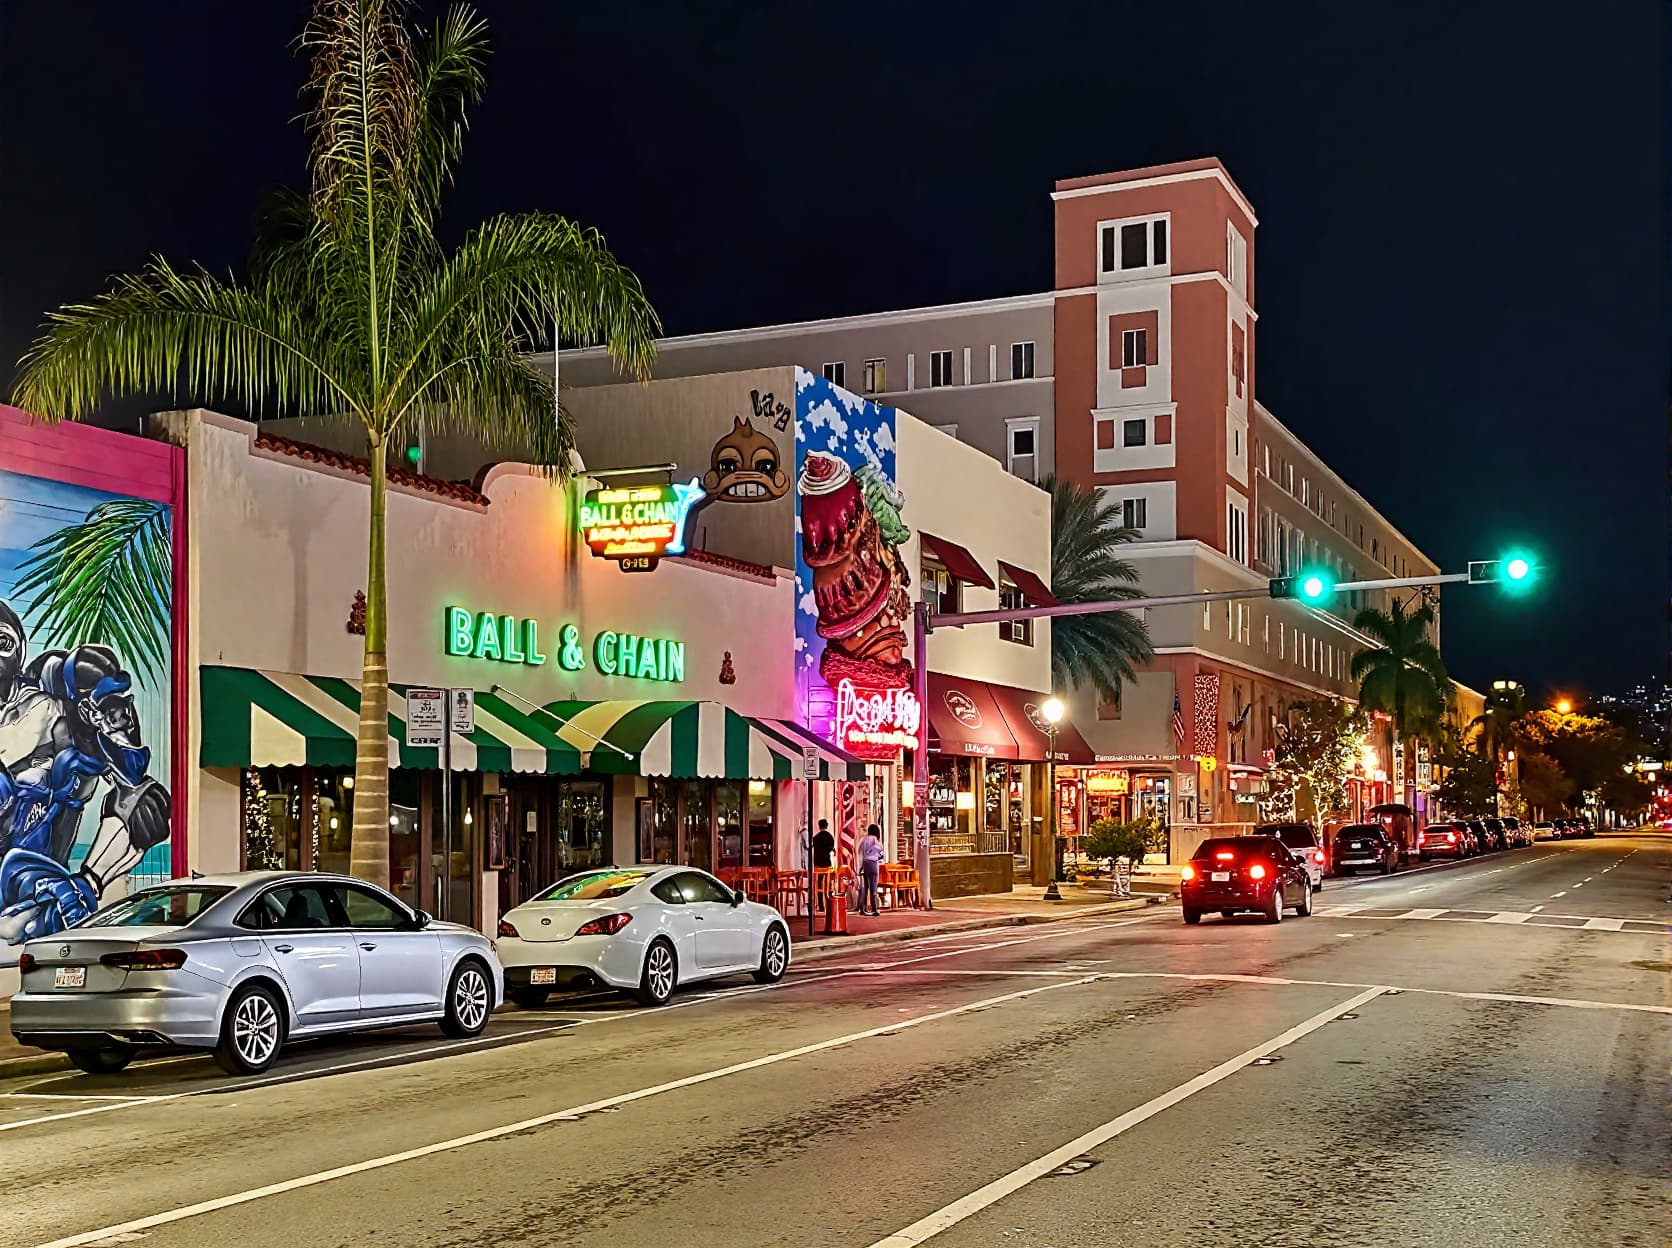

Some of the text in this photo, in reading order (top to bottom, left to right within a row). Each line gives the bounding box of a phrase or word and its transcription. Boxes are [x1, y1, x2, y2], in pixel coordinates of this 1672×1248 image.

[580, 501, 679, 528] BALL & CHAIN
[445, 605, 684, 682] BALL & CHAIN
